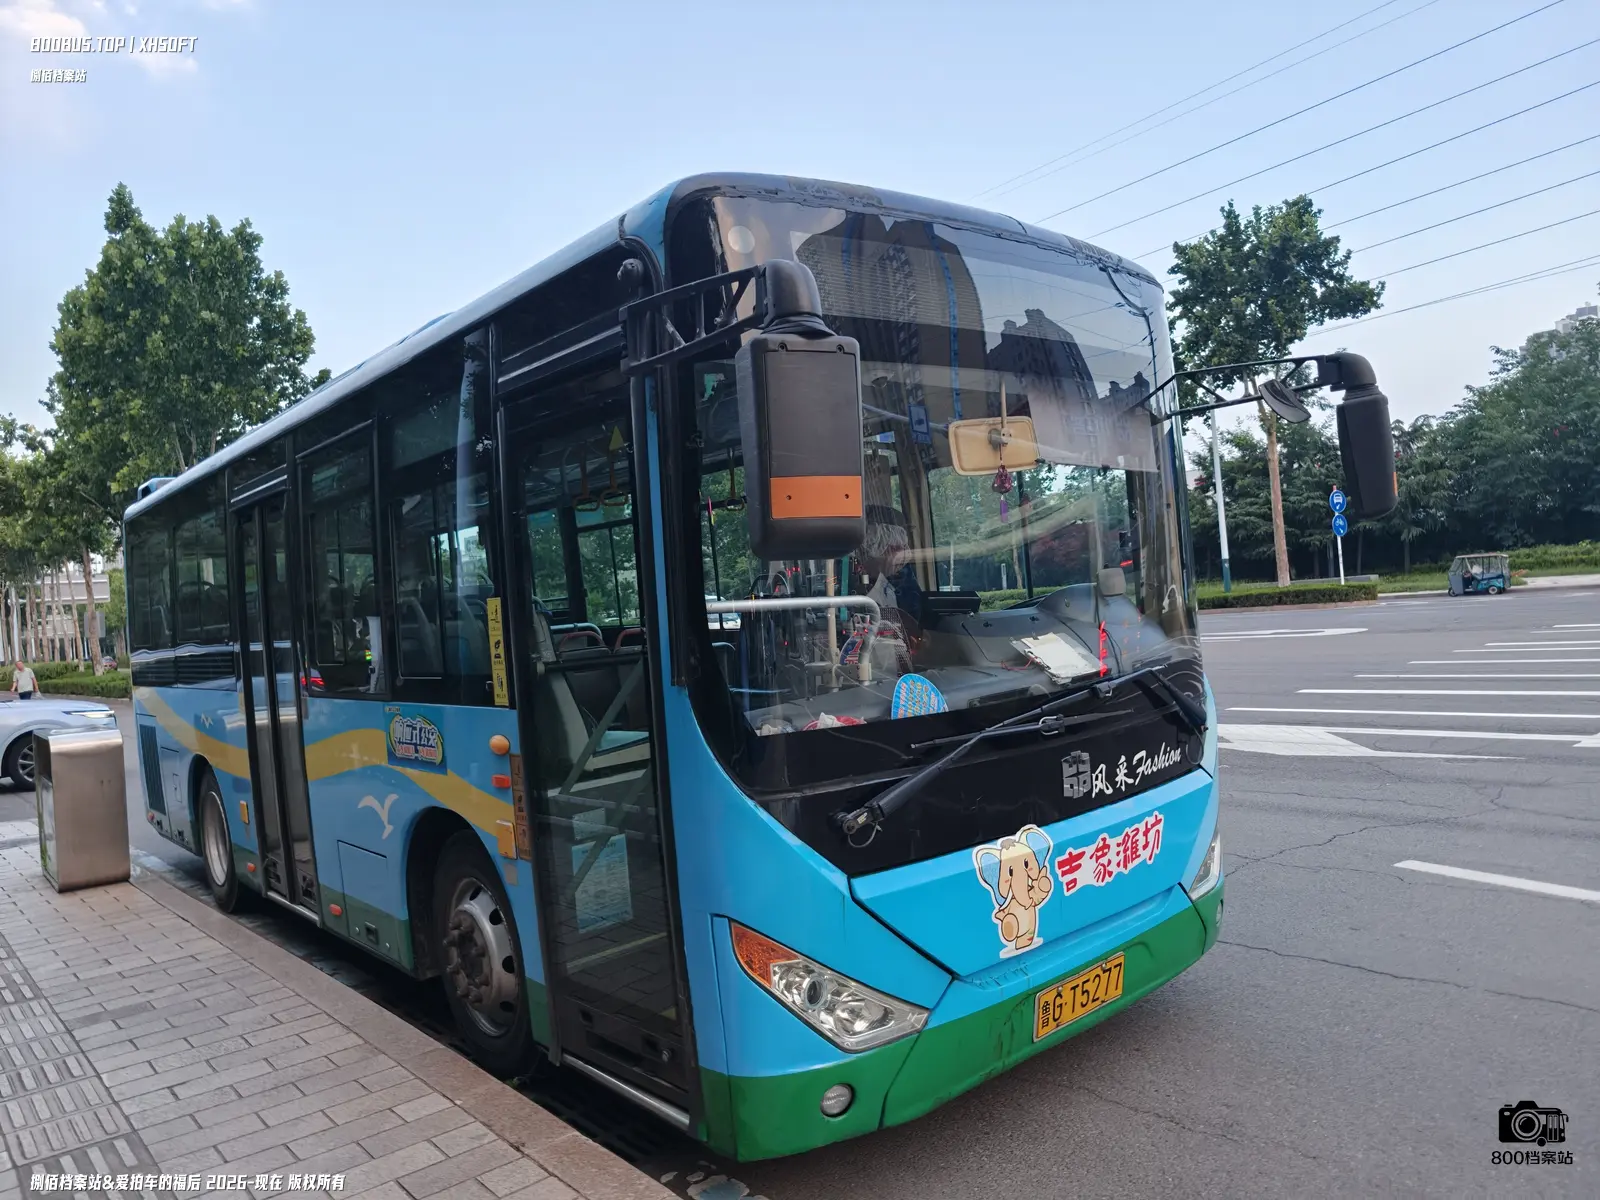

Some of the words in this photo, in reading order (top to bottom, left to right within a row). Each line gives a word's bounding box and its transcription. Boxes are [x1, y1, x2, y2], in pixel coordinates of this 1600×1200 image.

[1092, 755, 1135, 798] 风采
[1132, 742, 1182, 784] Fashion
[1057, 813, 1164, 893] 吉象潍坊
